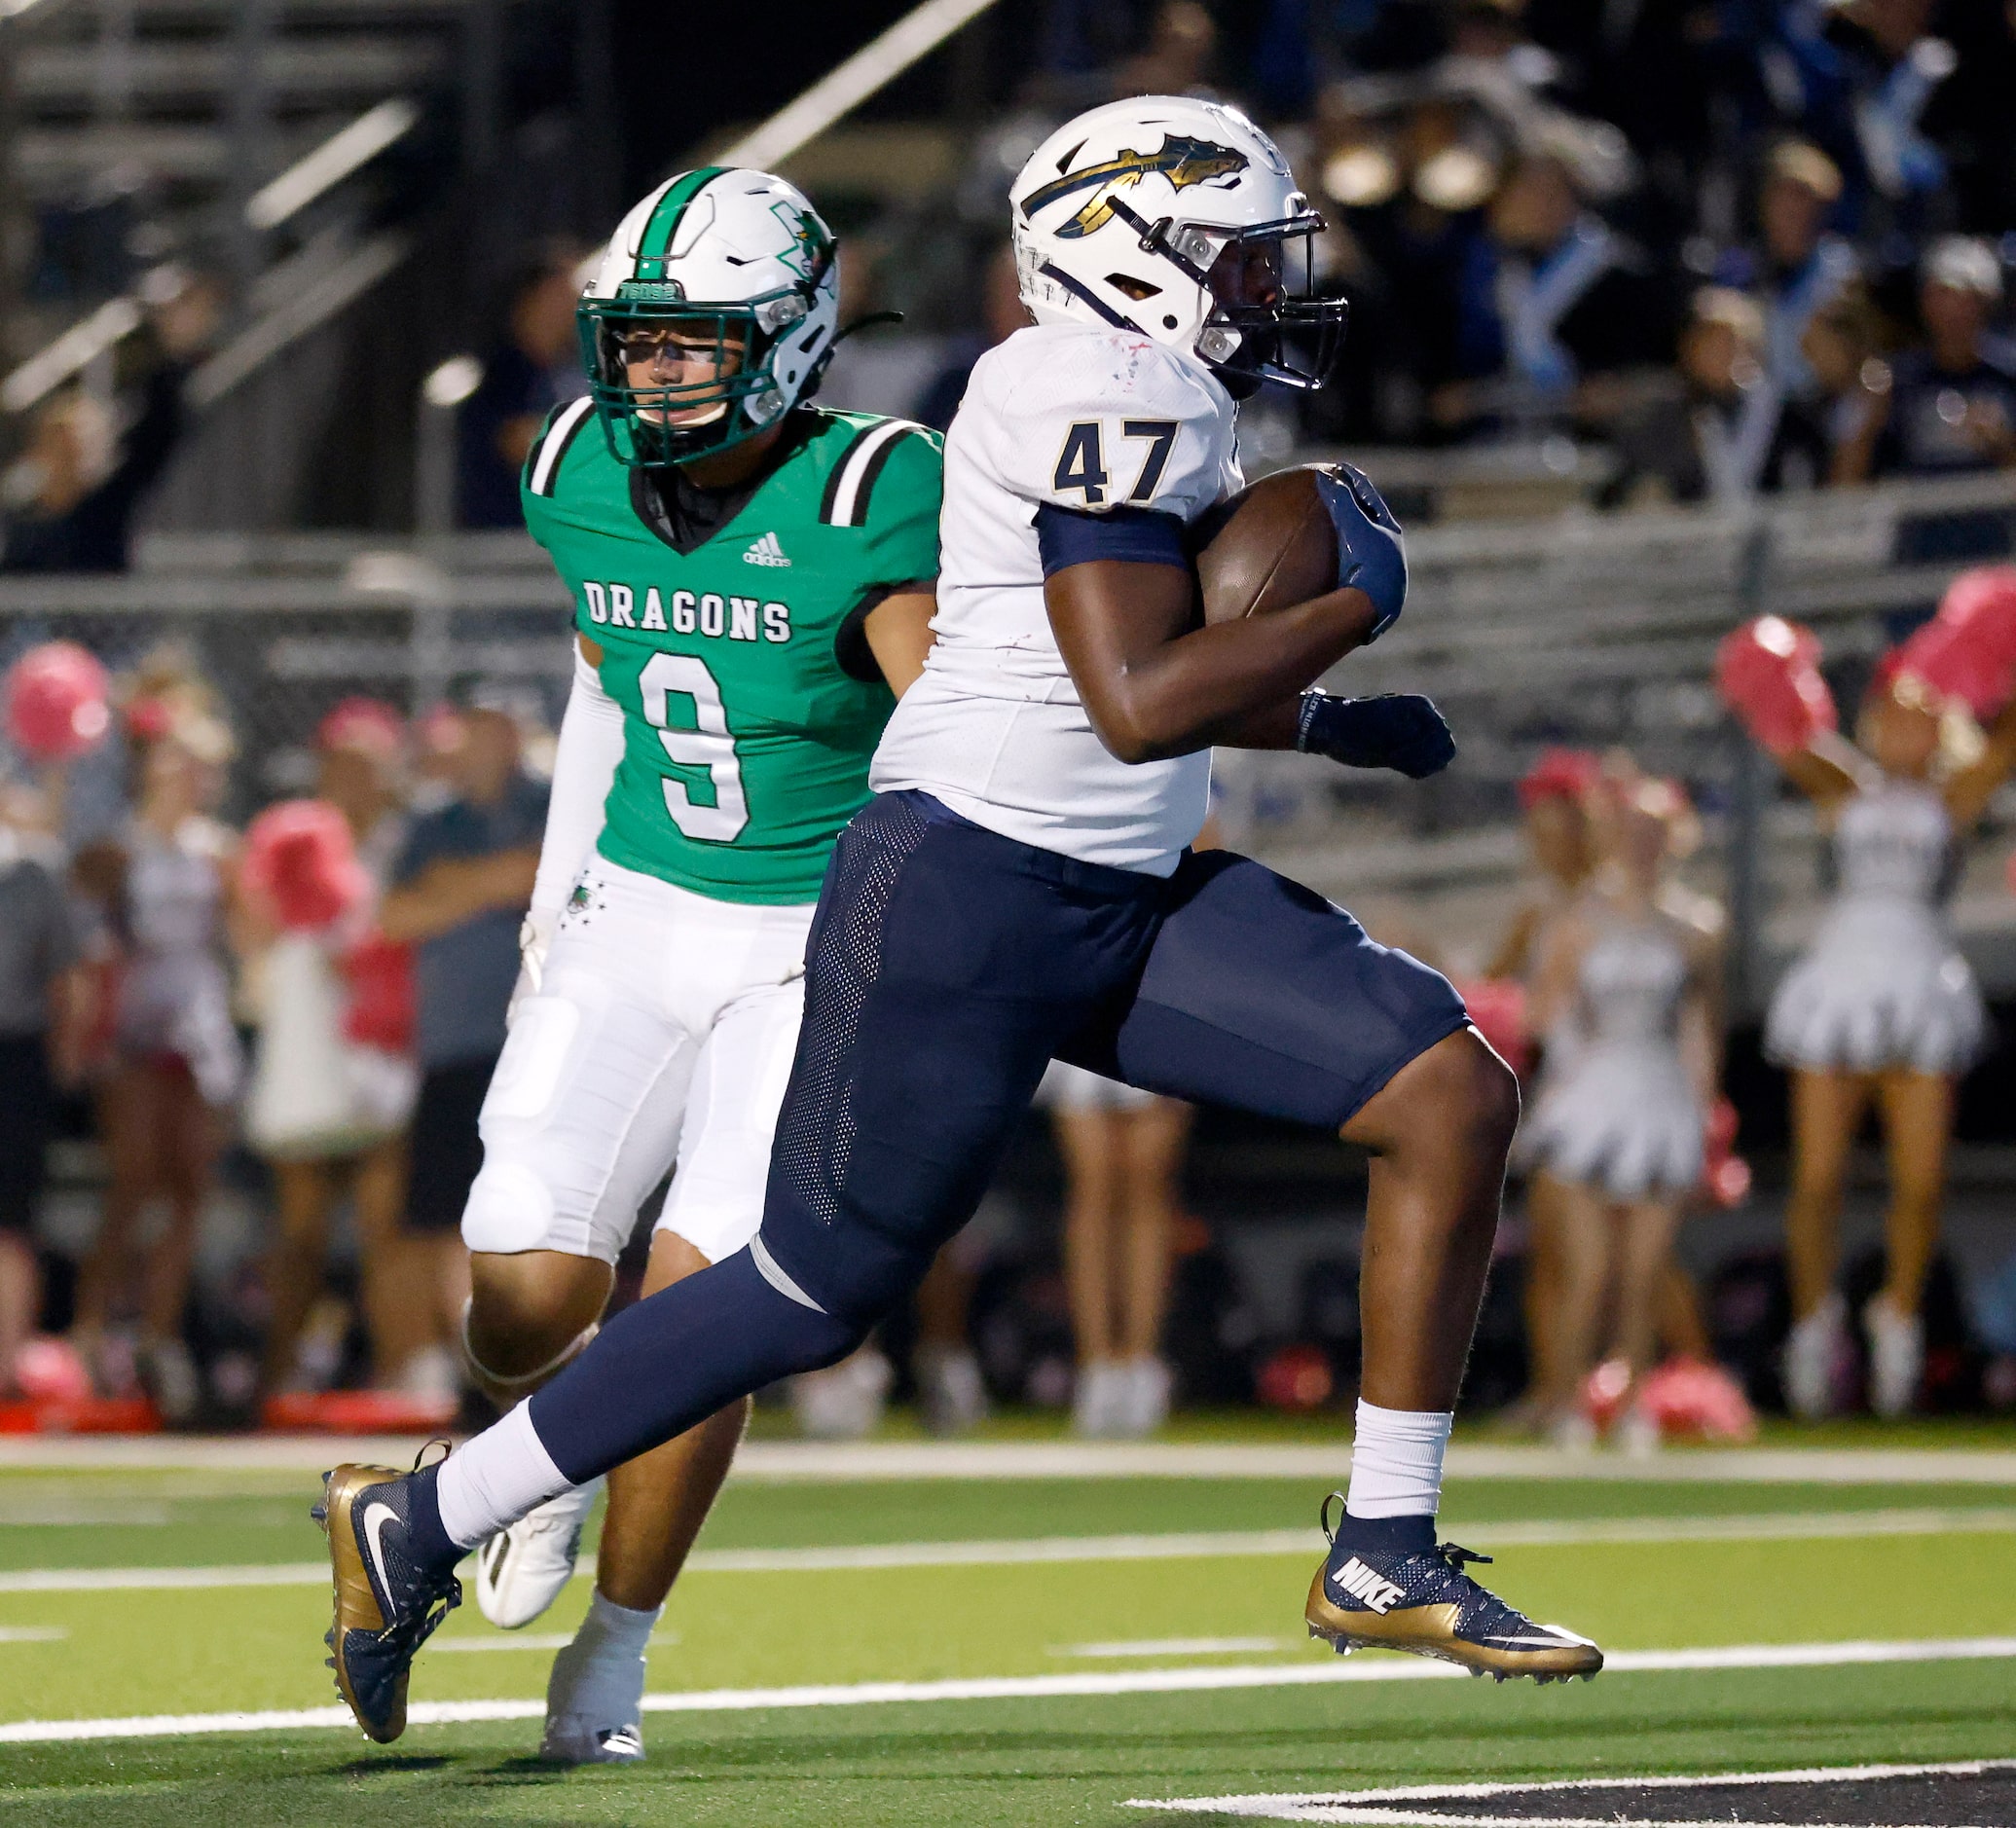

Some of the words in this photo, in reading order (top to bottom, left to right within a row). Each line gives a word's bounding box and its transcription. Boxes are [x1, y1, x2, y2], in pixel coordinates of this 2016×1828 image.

[620, 282, 676, 300] 76092
[1051, 418, 1182, 508] 47
[743, 552, 792, 567] adidas
[583, 581, 792, 643] DRAGONS
[639, 651, 750, 843] 9
[1331, 1555, 1408, 1616] NIKE
